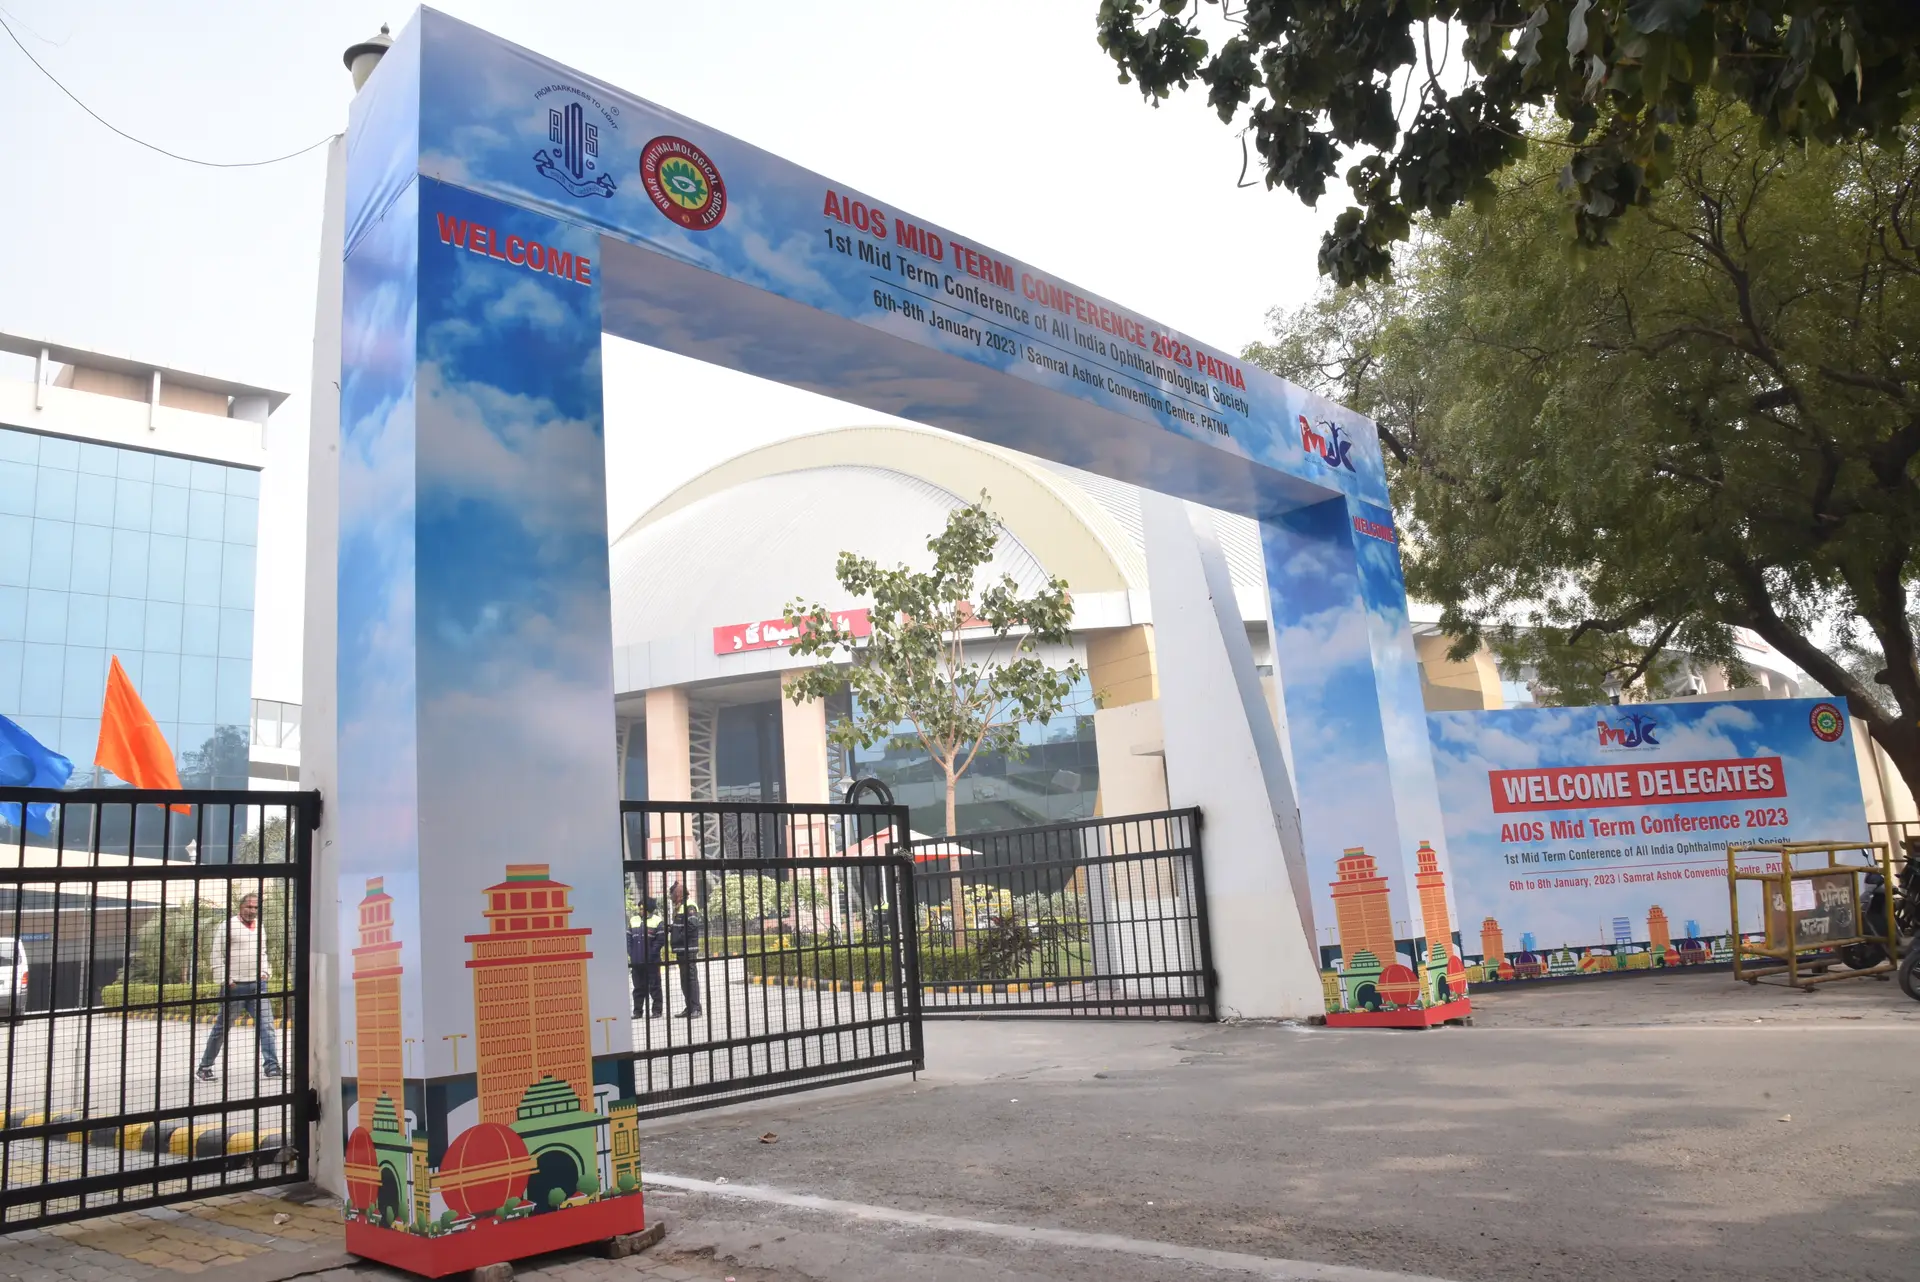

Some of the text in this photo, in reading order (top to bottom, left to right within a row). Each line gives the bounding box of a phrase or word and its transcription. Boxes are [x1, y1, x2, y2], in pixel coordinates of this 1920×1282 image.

[534, 84, 619, 130] FROM DARKNESS TO LIGHT
[645, 142, 719, 186] OPHTHALMOLOGICAL
[648, 178, 670, 210] BIHAR
[701, 191, 722, 224] SOCIETY
[437, 211, 592, 286] WELCOME
[823, 189, 1247, 393] AIOS MID TERM CONFERENCE 2023 PATNA
[824, 228, 1249, 418] 1st Mid Term Conference of All India Ophthalmological Society
[873, 289, 925, 323] 6th-8th
[928, 311, 982, 347] January
[986, 330, 1017, 356] 2023
[1028, 346, 1069, 376] Samrat
[1072, 364, 1105, 390] Ashok
[1107, 377, 1163, 412] Convention
[1165, 402, 1199, 427] Centre,
[1201, 413, 1230, 438] PATNA
[1353, 515, 1396, 545] WELCOME
[1502, 764, 1775, 804] WELCOME DELEGATES
[1500, 807, 1789, 843] AIOS Mid Term Conference 2023
[1504, 853, 1519, 865] 1st
[1521, 852, 1540, 863] Mid
[1542, 851, 1566, 862] Term
[1569, 847, 1621, 861] Conference
[1624, 846, 1633, 857] of
[1636, 845, 1648, 857] All
[1651, 843, 1674, 855] India
[1509, 880, 1523, 891] 6th
[1526, 880, 1535, 890] to
[1537, 878, 1552, 889] 8th
[1554, 876, 1592, 889] January,
[1594, 874, 1615, 885] 2023
[1623, 872, 1655, 884] Samrat
[1657, 870, 1683, 881] Ashok
[1765, 862, 1794, 873] PATA
[1819, 882, 1850, 912] पुलिस
[1800, 917, 1830, 936] पटना
